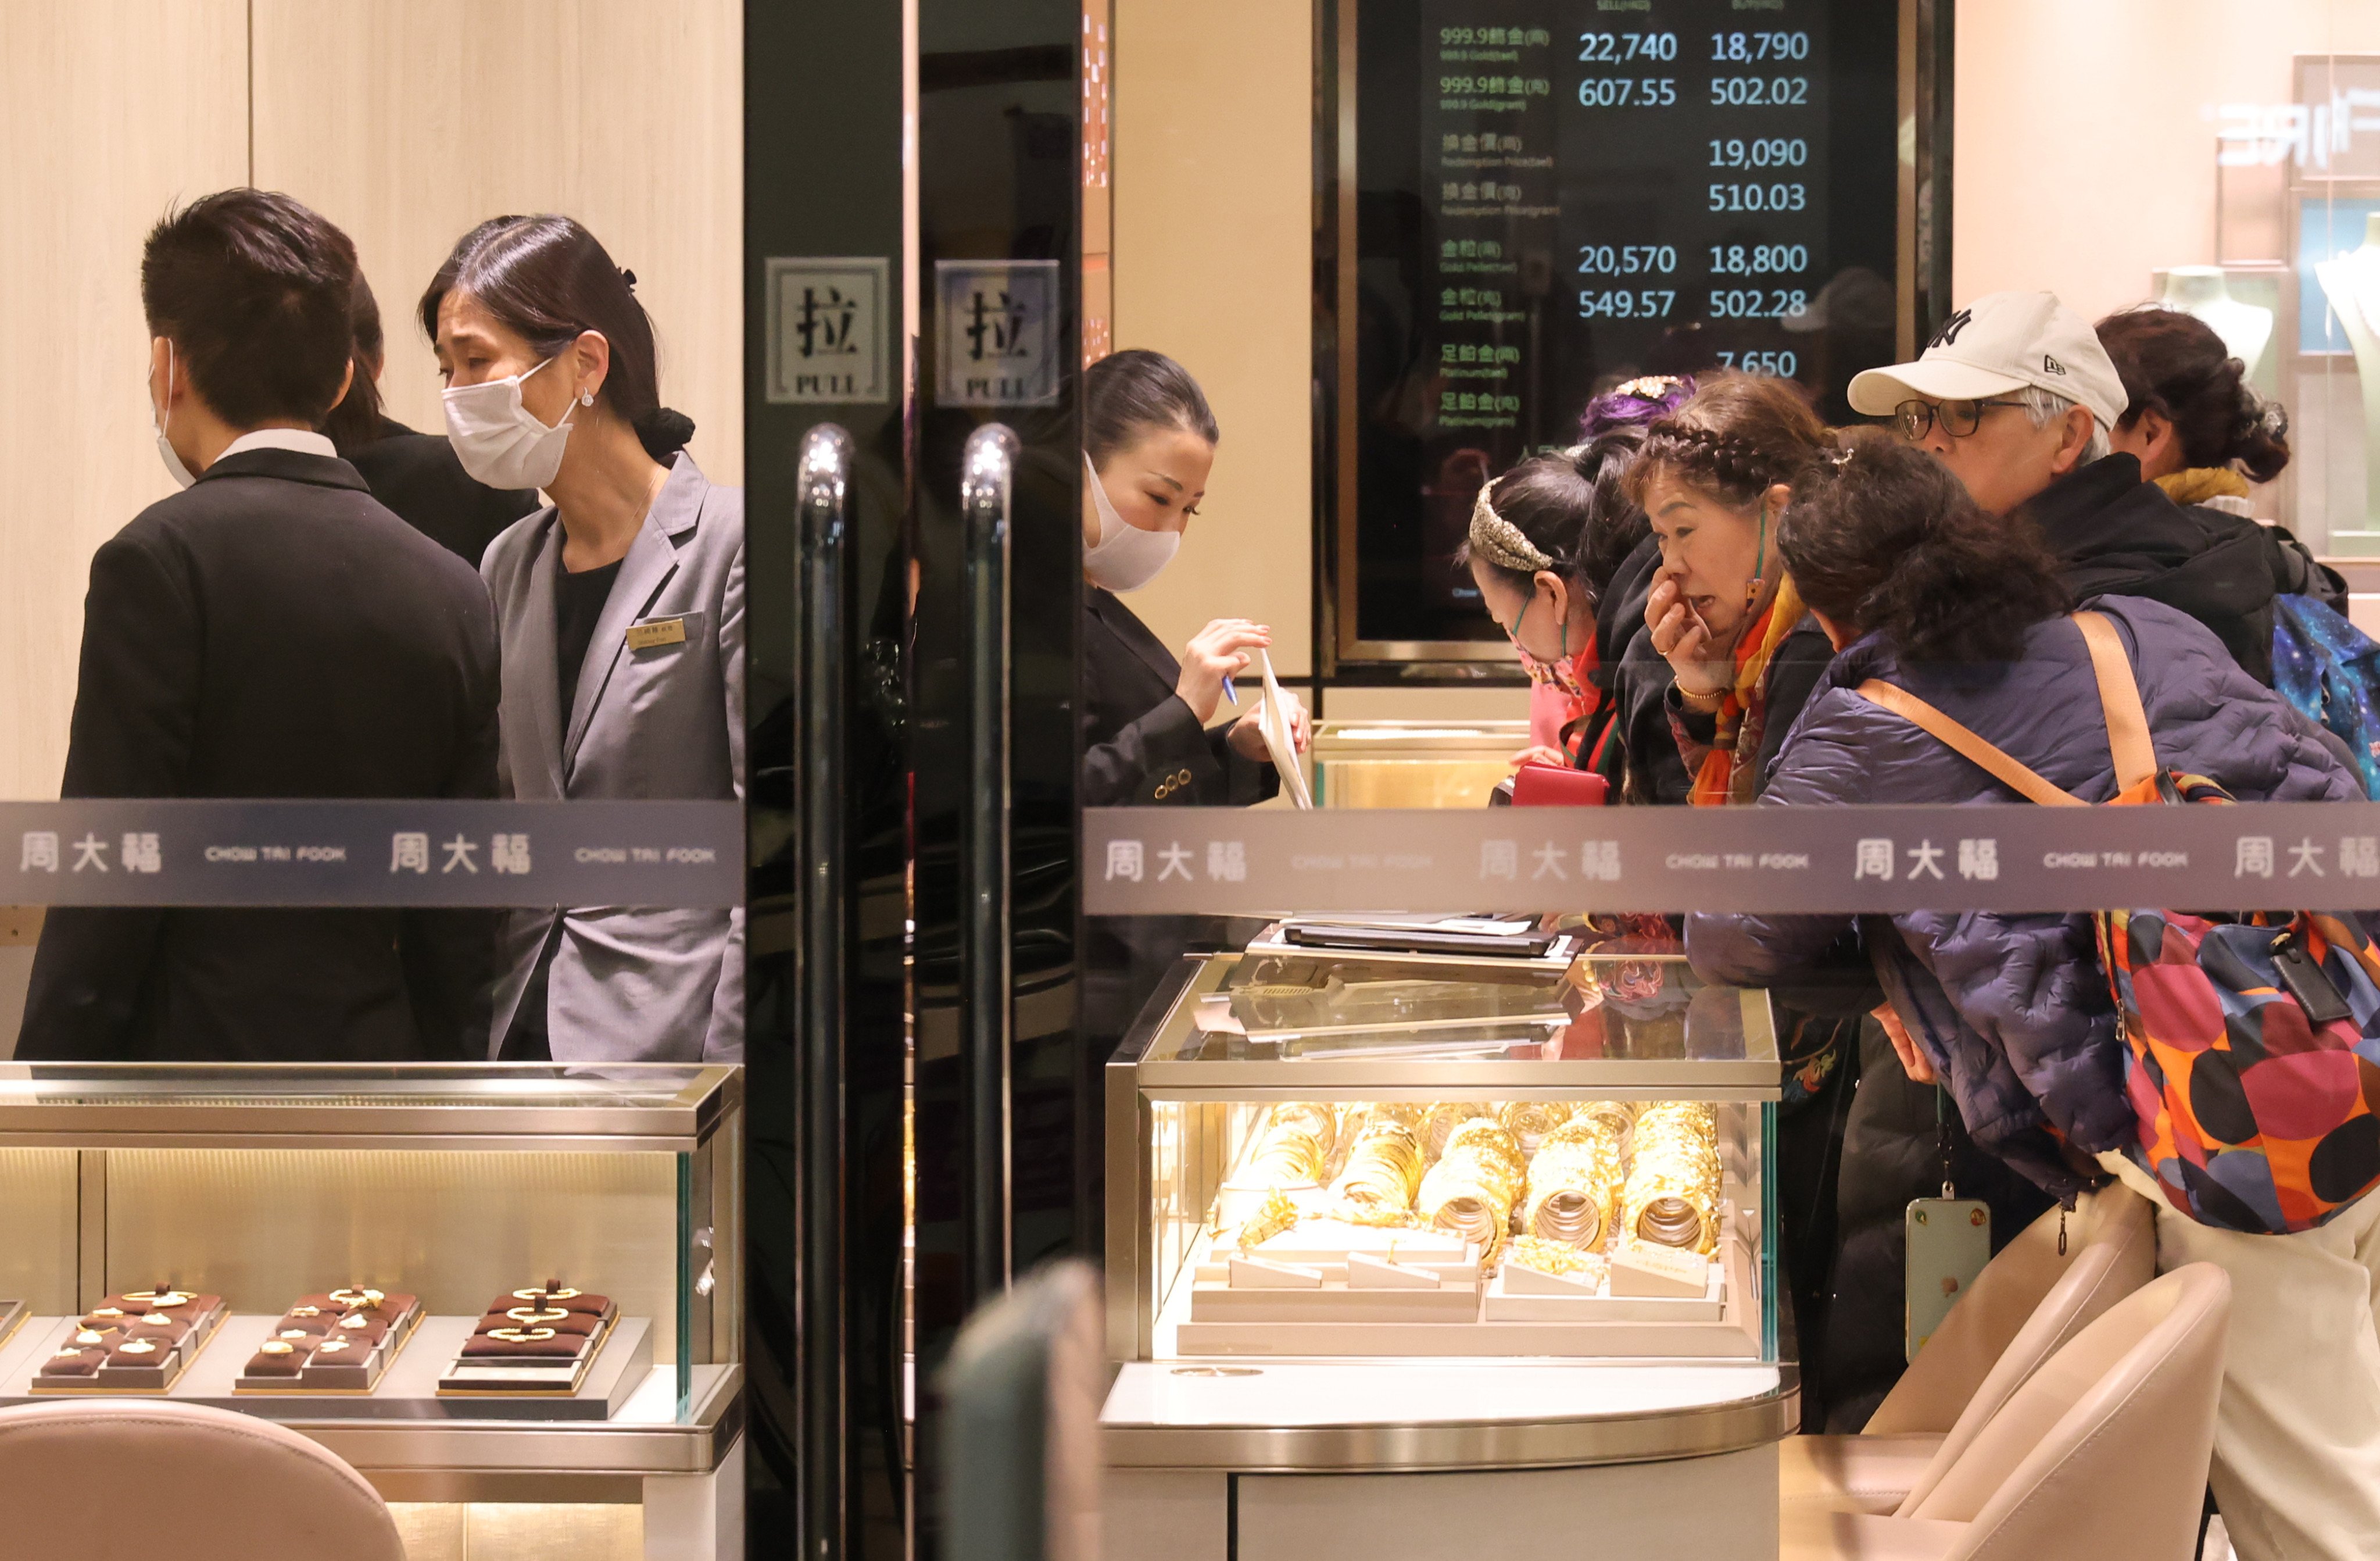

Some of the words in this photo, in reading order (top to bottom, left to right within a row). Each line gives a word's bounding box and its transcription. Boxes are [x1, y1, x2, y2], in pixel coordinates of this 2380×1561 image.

[1579, 33, 1677, 64] 22,740
[1711, 32, 1808, 63] 18,790
[1579, 78, 1677, 106] 607.55
[1710, 77, 1808, 105] 502.02
[1709, 138, 1807, 170] 19,090
[1709, 183, 1806, 212] 510.03
[1579, 245, 1677, 277] 20,570
[1710, 245, 1808, 277] 18,800
[1579, 290, 1676, 318] 549.57
[1710, 290, 1808, 319] 502.28
[796, 286, 858, 358] 拉
[966, 291, 1028, 362] 拉
[1716, 351, 1797, 378] 7650
[796, 374, 856, 396] PULL
[966, 377, 1026, 399] PULL
[20, 831, 162, 874] 周大福
[205, 846, 257, 863] CHOW
[263, 846, 291, 863] TAI
[296, 846, 346, 863] FOOK
[389, 832, 531, 874] 周大福
[575, 847, 626, 863] CHOW
[632, 847, 661, 863] TAI
[667, 847, 716, 863] FOOK
[1105, 840, 1247, 883] 周大福
[1480, 838, 1622, 882] 周大福
[1666, 853, 1717, 870] CHOW
[1723, 853, 1752, 870] TAI
[1760, 853, 1809, 870] FOOK
[1854, 837, 1999, 881] 周大福
[2043, 852, 2097, 869] CHOW
[2103, 852, 2132, 869] TAI
[2138, 852, 2188, 869] FOOK
[2234, 836, 2380, 878] 周大福
